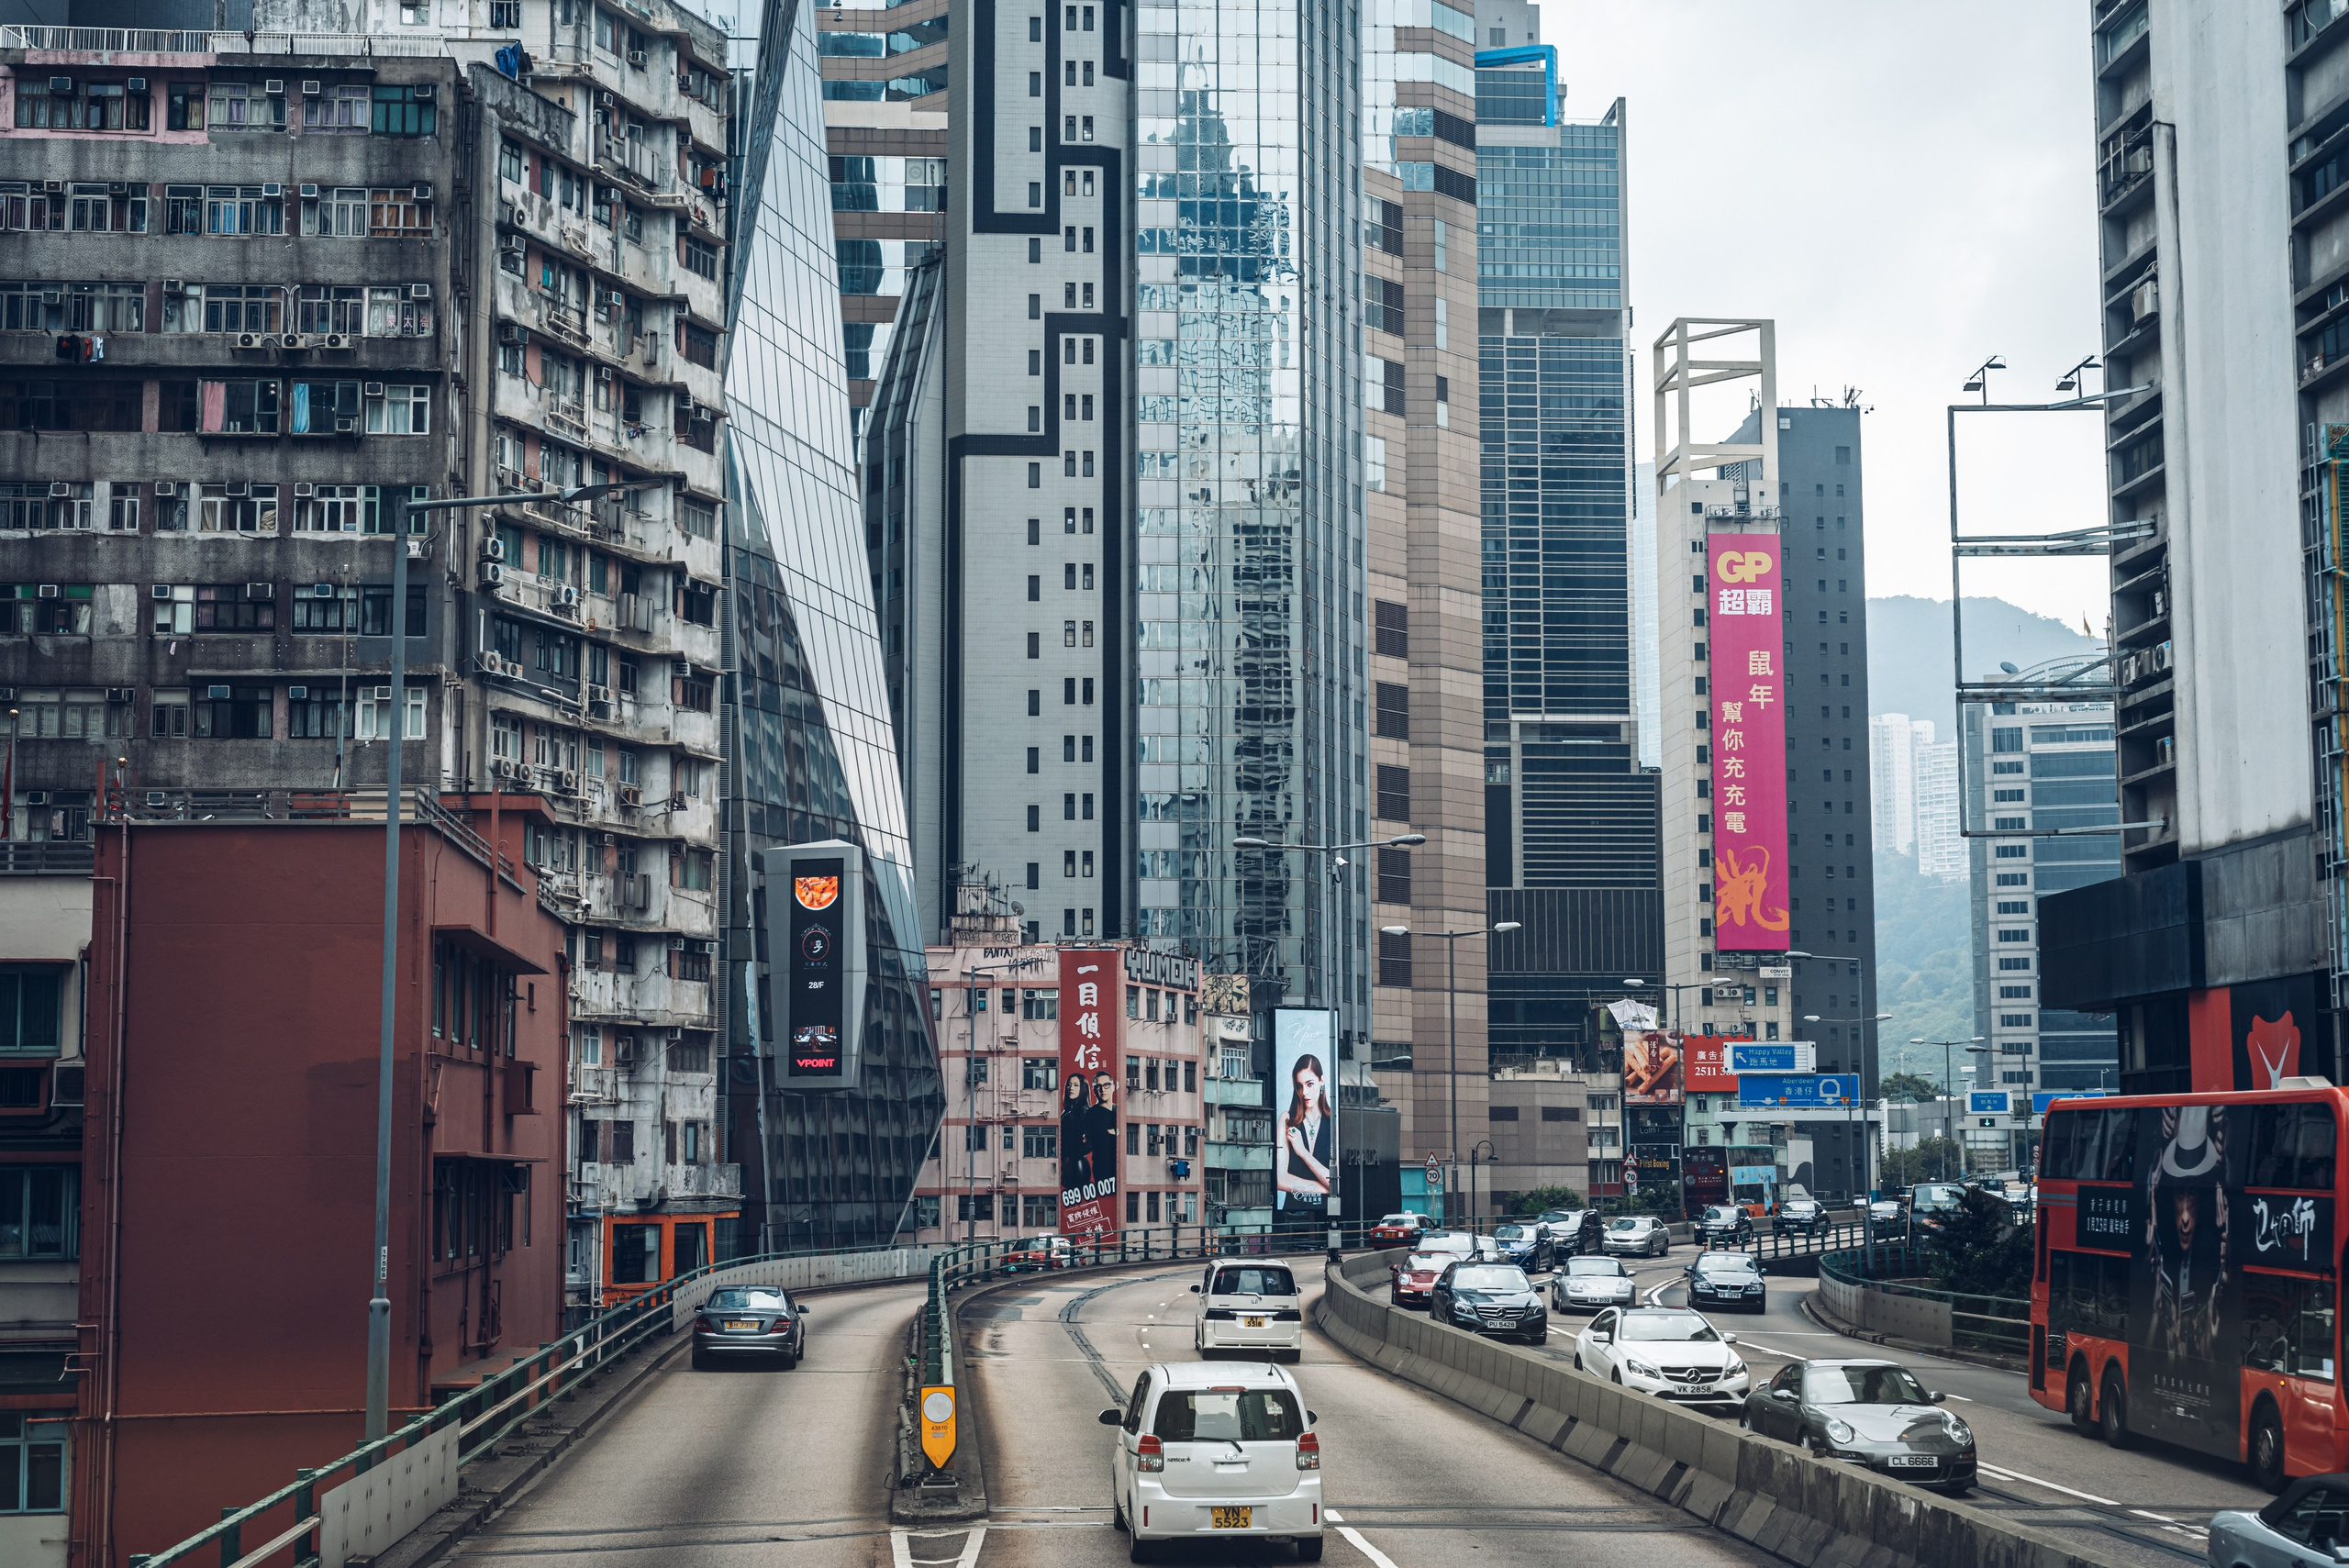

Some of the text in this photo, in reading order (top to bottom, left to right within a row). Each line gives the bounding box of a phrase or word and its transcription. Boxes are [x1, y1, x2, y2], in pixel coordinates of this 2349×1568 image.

[1717, 551, 1772, 583] GP
[1719, 589, 1772, 615] 超霸
[1748, 650, 1774, 710] 鼠年
[1721, 701, 1747, 834] 幫你充充電
[796, 1058, 835, 1068] VPOINT
[1749, 1057, 1778, 1066] 跑馬地
[1695, 1067, 1716, 1076] 2511
[1784, 1087, 1813, 1095] 香港仔
[1639, 1159, 1670, 1170] First Boxing
[1063, 1177, 1115, 1207] 699 00 007
[1893, 1457, 1934, 1466] CL 6666
[1224, 1507, 1241, 1518] VN
[1215, 1517, 1249, 1529] 5523
